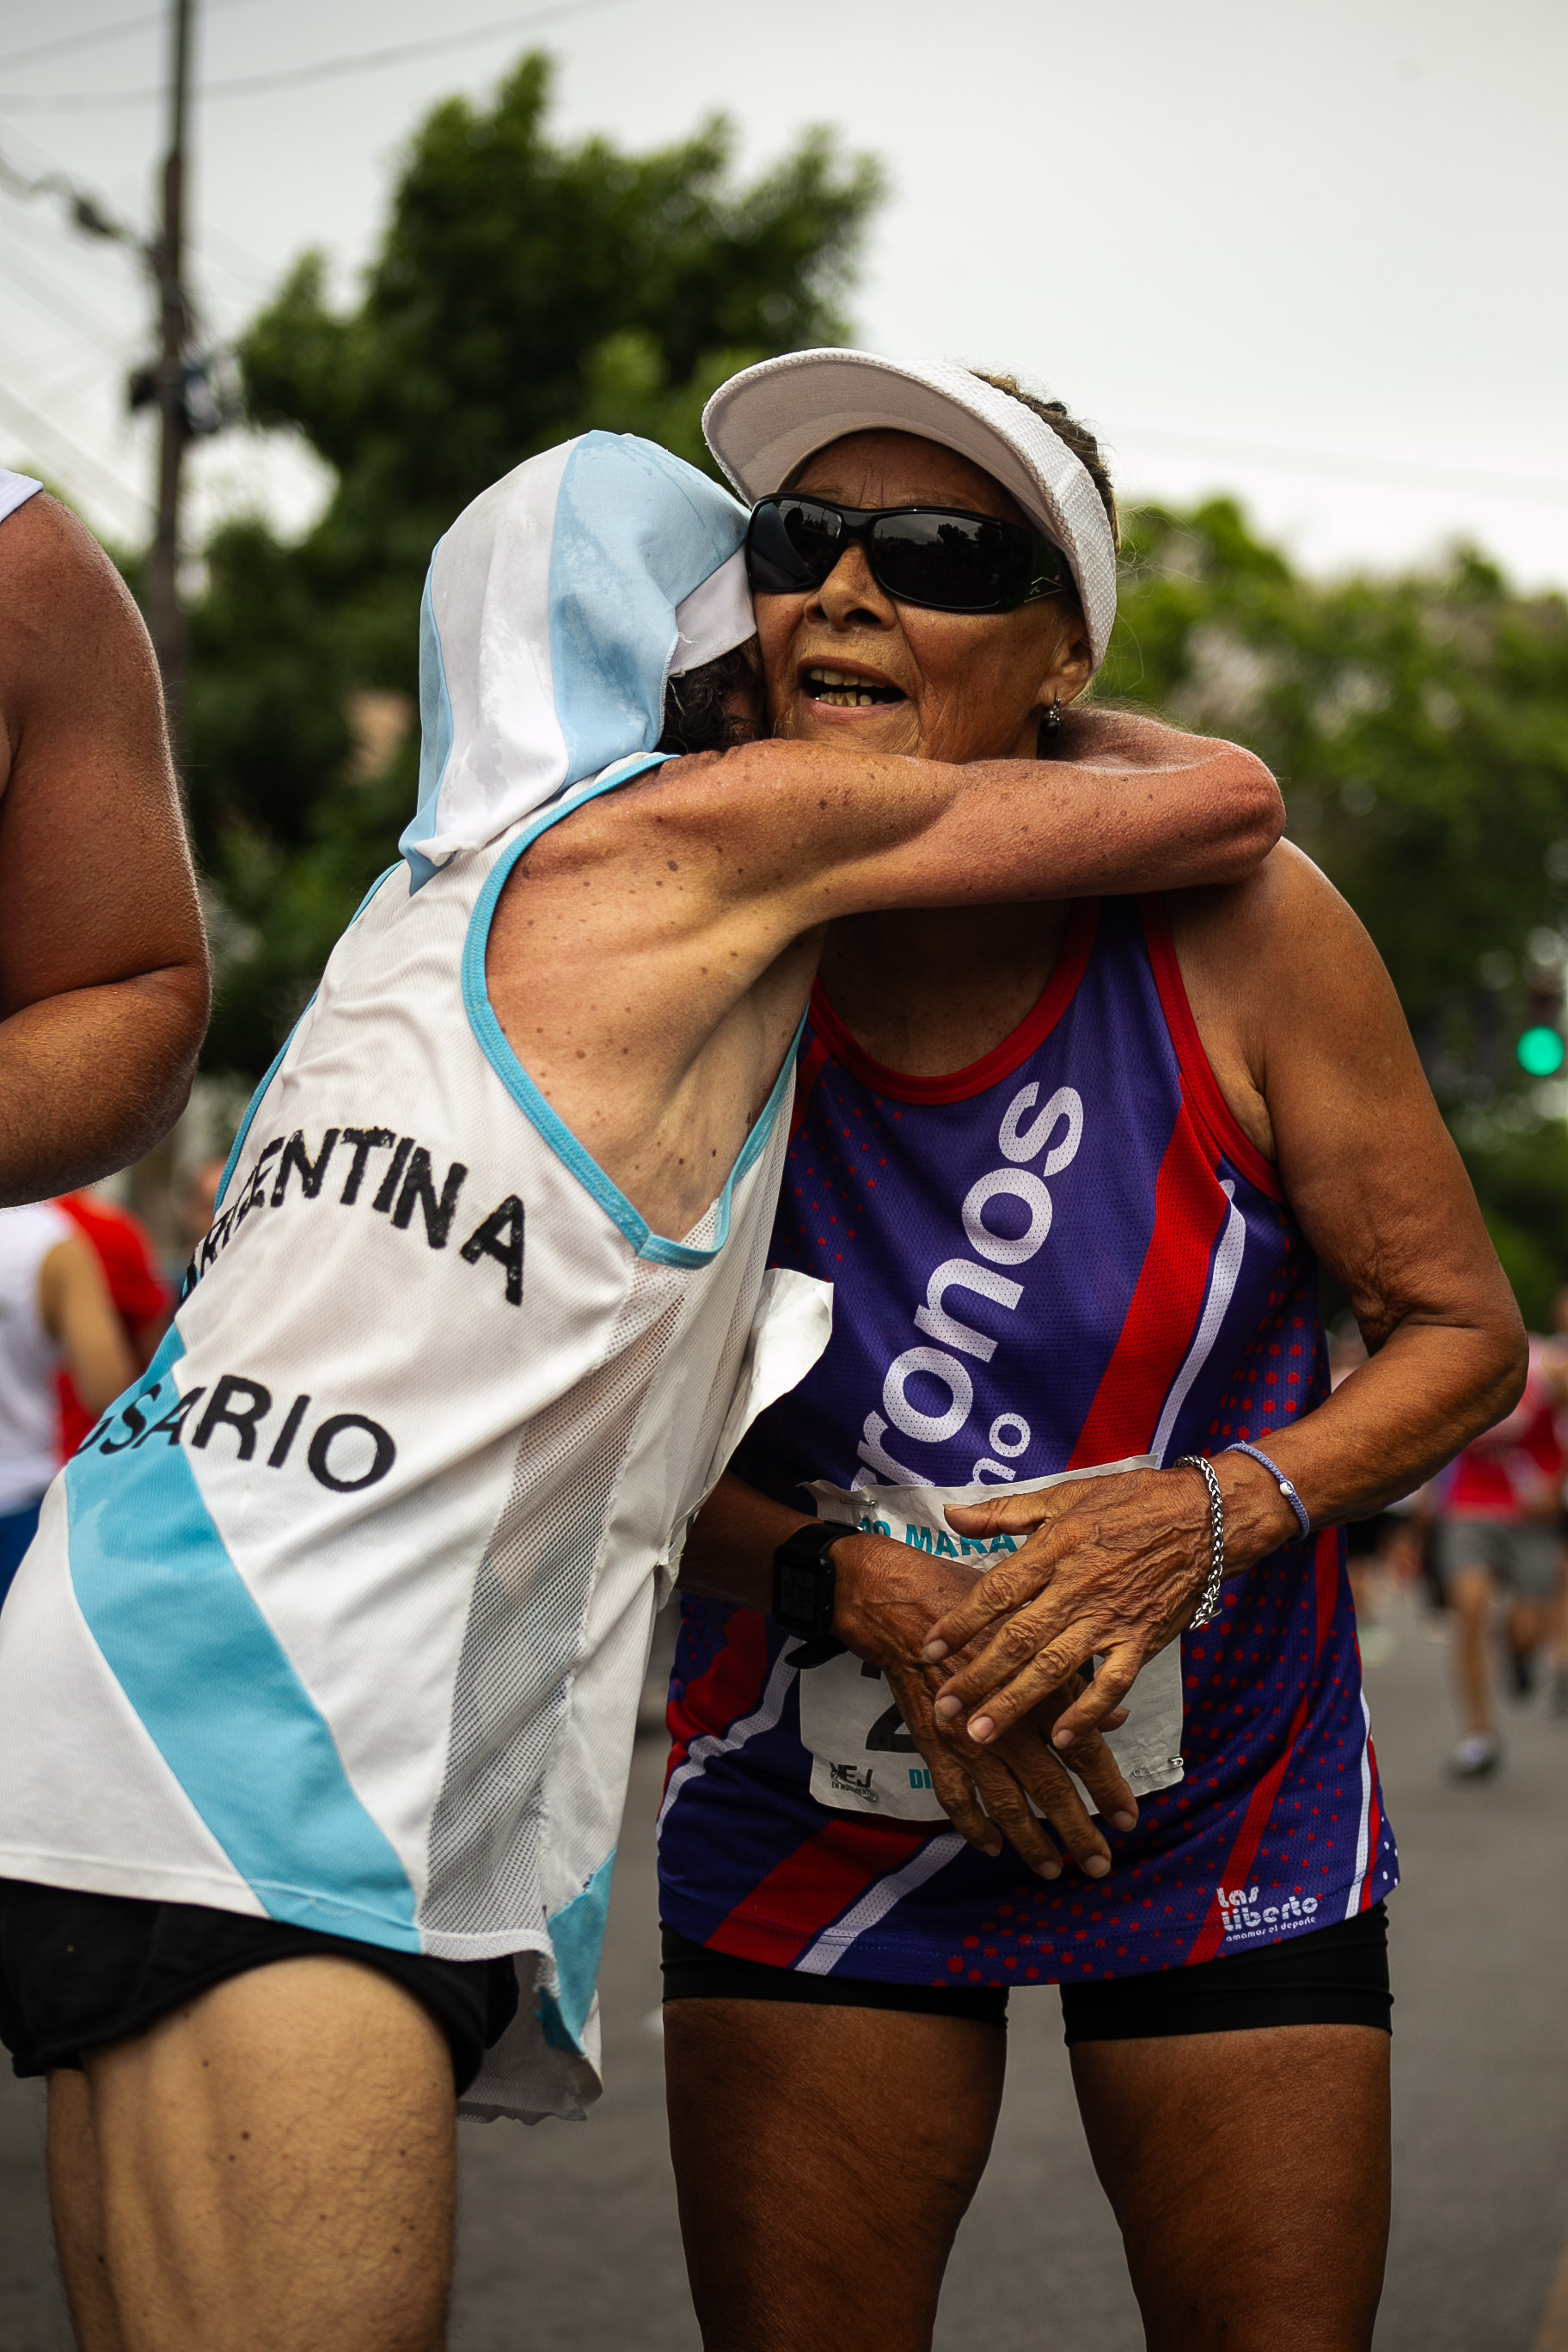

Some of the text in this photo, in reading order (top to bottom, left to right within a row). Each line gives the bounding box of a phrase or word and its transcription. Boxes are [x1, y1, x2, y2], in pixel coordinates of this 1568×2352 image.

[851, 1081, 1084, 1491] ronos
[905, 1523, 1029, 1558] MARA
[1226, 1916, 1317, 1942] amamos el deporte
